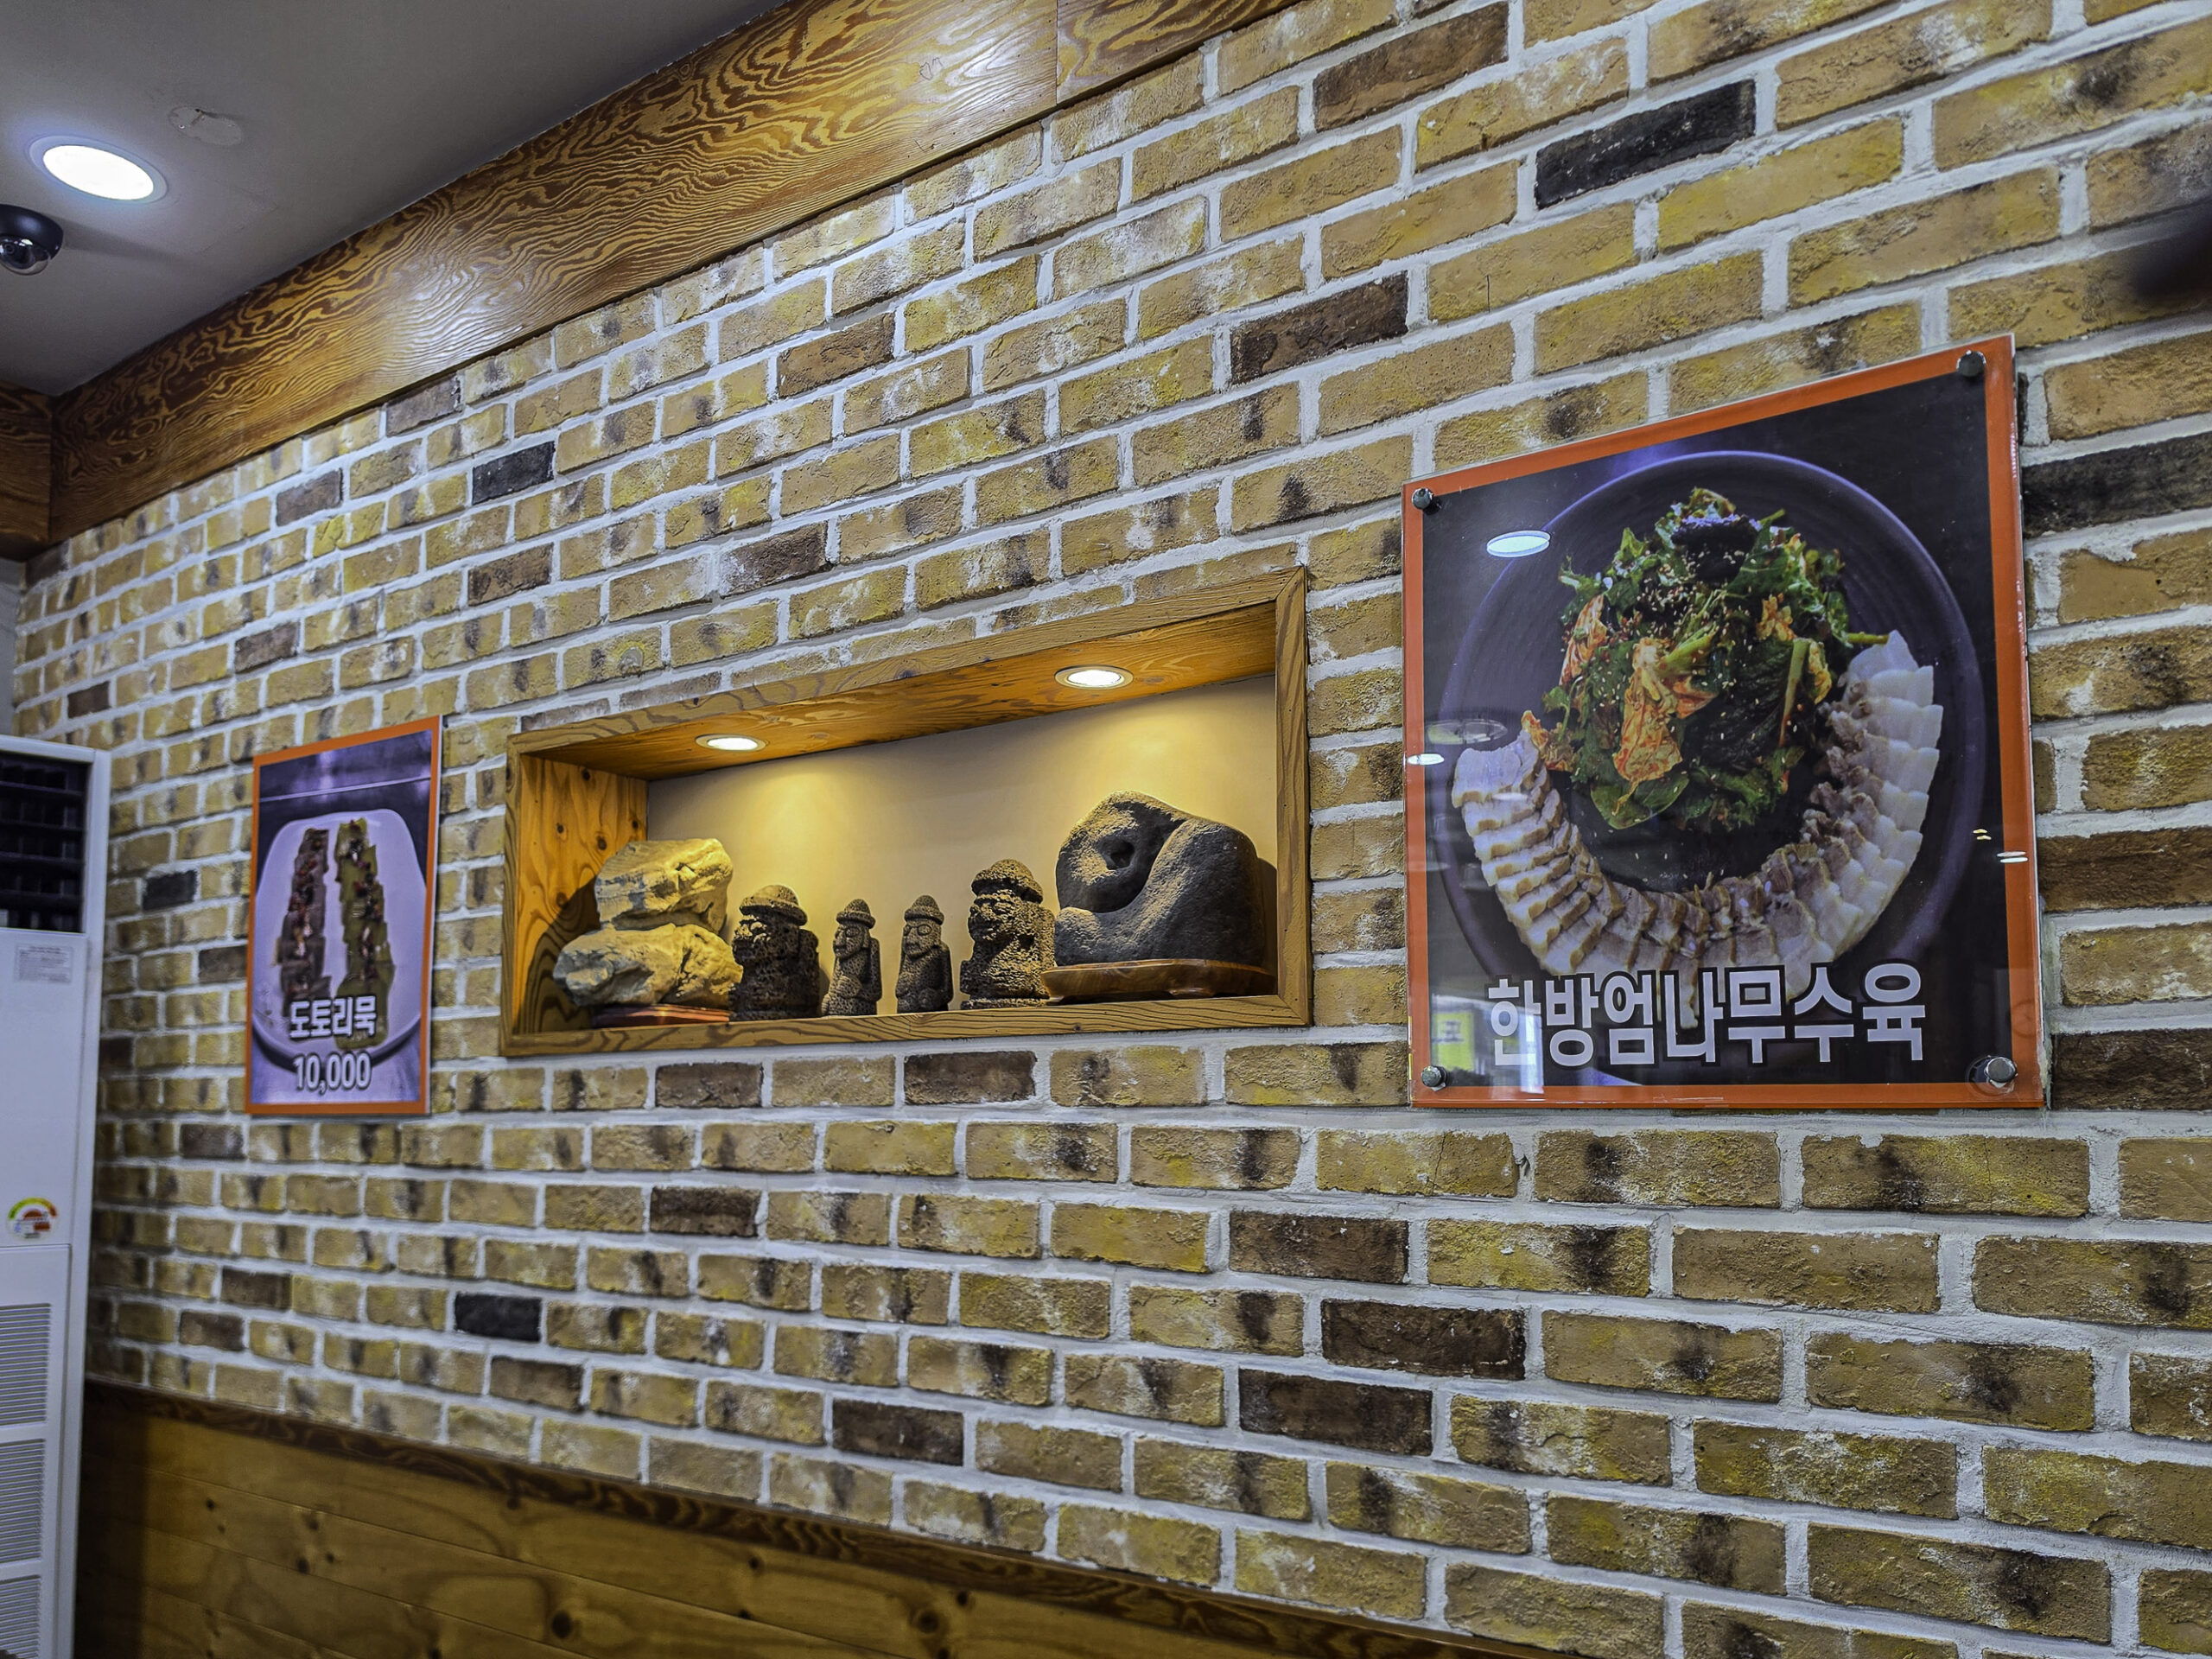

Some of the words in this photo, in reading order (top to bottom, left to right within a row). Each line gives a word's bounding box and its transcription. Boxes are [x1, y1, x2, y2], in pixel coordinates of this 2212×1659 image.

[289, 995, 377, 1038] 도토리묵
[1488, 963, 1926, 1067] 한방엄나무수육
[293, 1052, 372, 1094] 10,000
